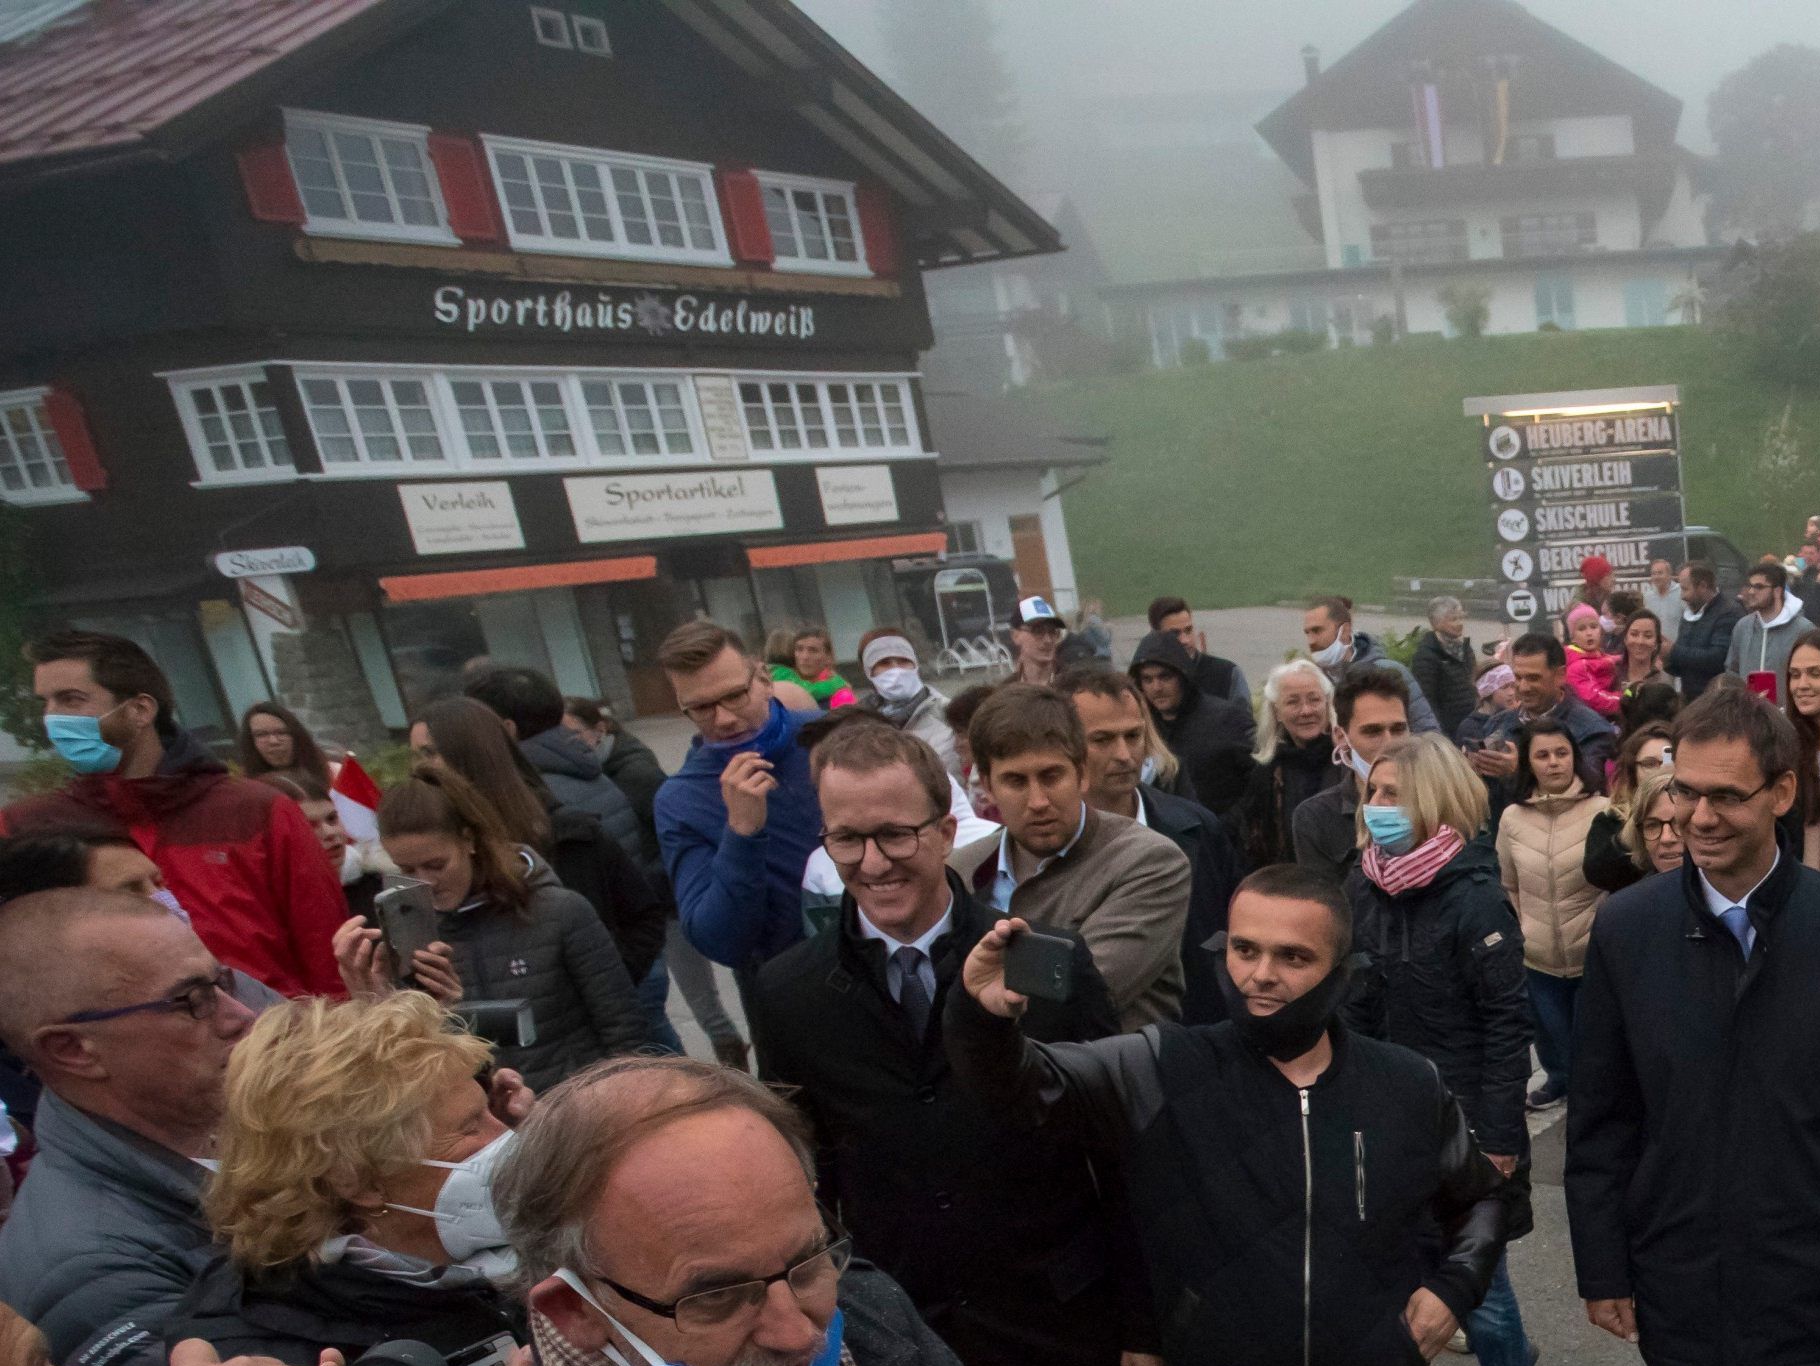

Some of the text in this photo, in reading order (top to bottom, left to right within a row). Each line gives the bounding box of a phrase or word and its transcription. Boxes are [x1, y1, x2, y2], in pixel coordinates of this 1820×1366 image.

[673, 294, 815, 339] Edelweiß
[1526, 416, 1672, 449] HEUBERG-ARENA
[1532, 461, 1632, 491] SKIVERLEIH
[421, 494, 496, 512] Verleih
[604, 474, 746, 511] Sportartikel
[1535, 502, 1630, 532] SKISCHULE
